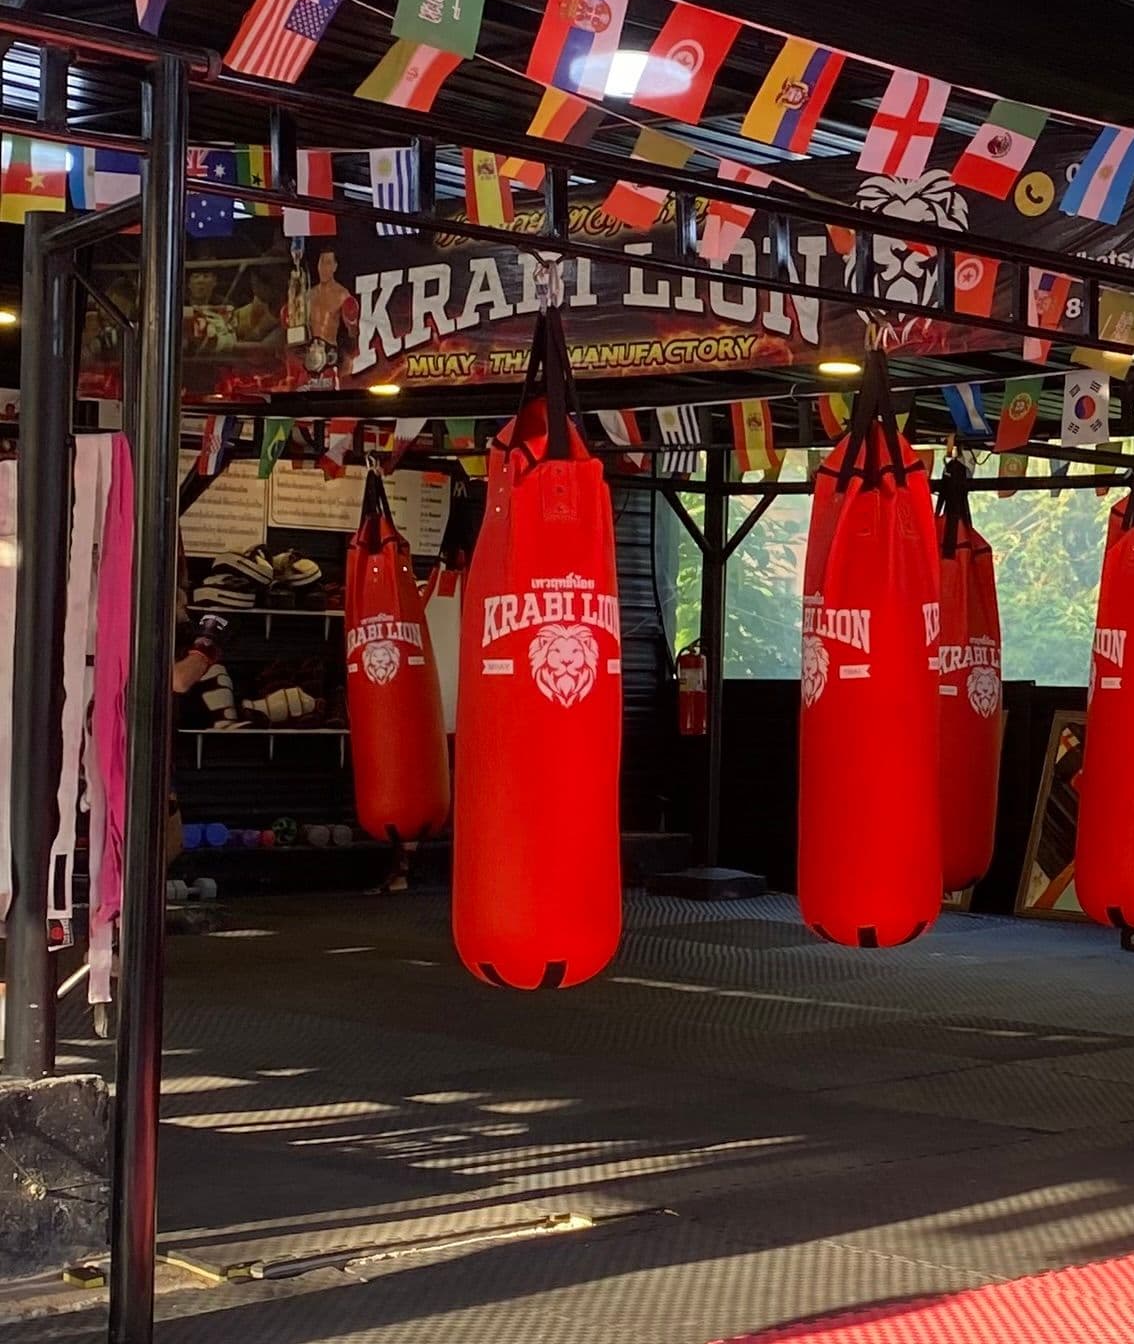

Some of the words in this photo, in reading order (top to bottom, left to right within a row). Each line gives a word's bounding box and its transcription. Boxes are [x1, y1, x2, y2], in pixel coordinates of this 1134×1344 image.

[352, 252, 598, 375] KRABI
[622, 236, 827, 344] LION
[406, 353, 477, 378] MUAY
[490, 349, 544, 375] THA
[570, 335, 757, 370] MANUFACTORY
[347, 623, 384, 659] RABI
[386, 622, 423, 650] LION
[482, 592, 576, 648] KRABI
[581, 592, 621, 647] LION
[816, 609, 871, 654] LION
[939, 645, 988, 676] KRABI
[1095, 628, 1127, 668] ION
